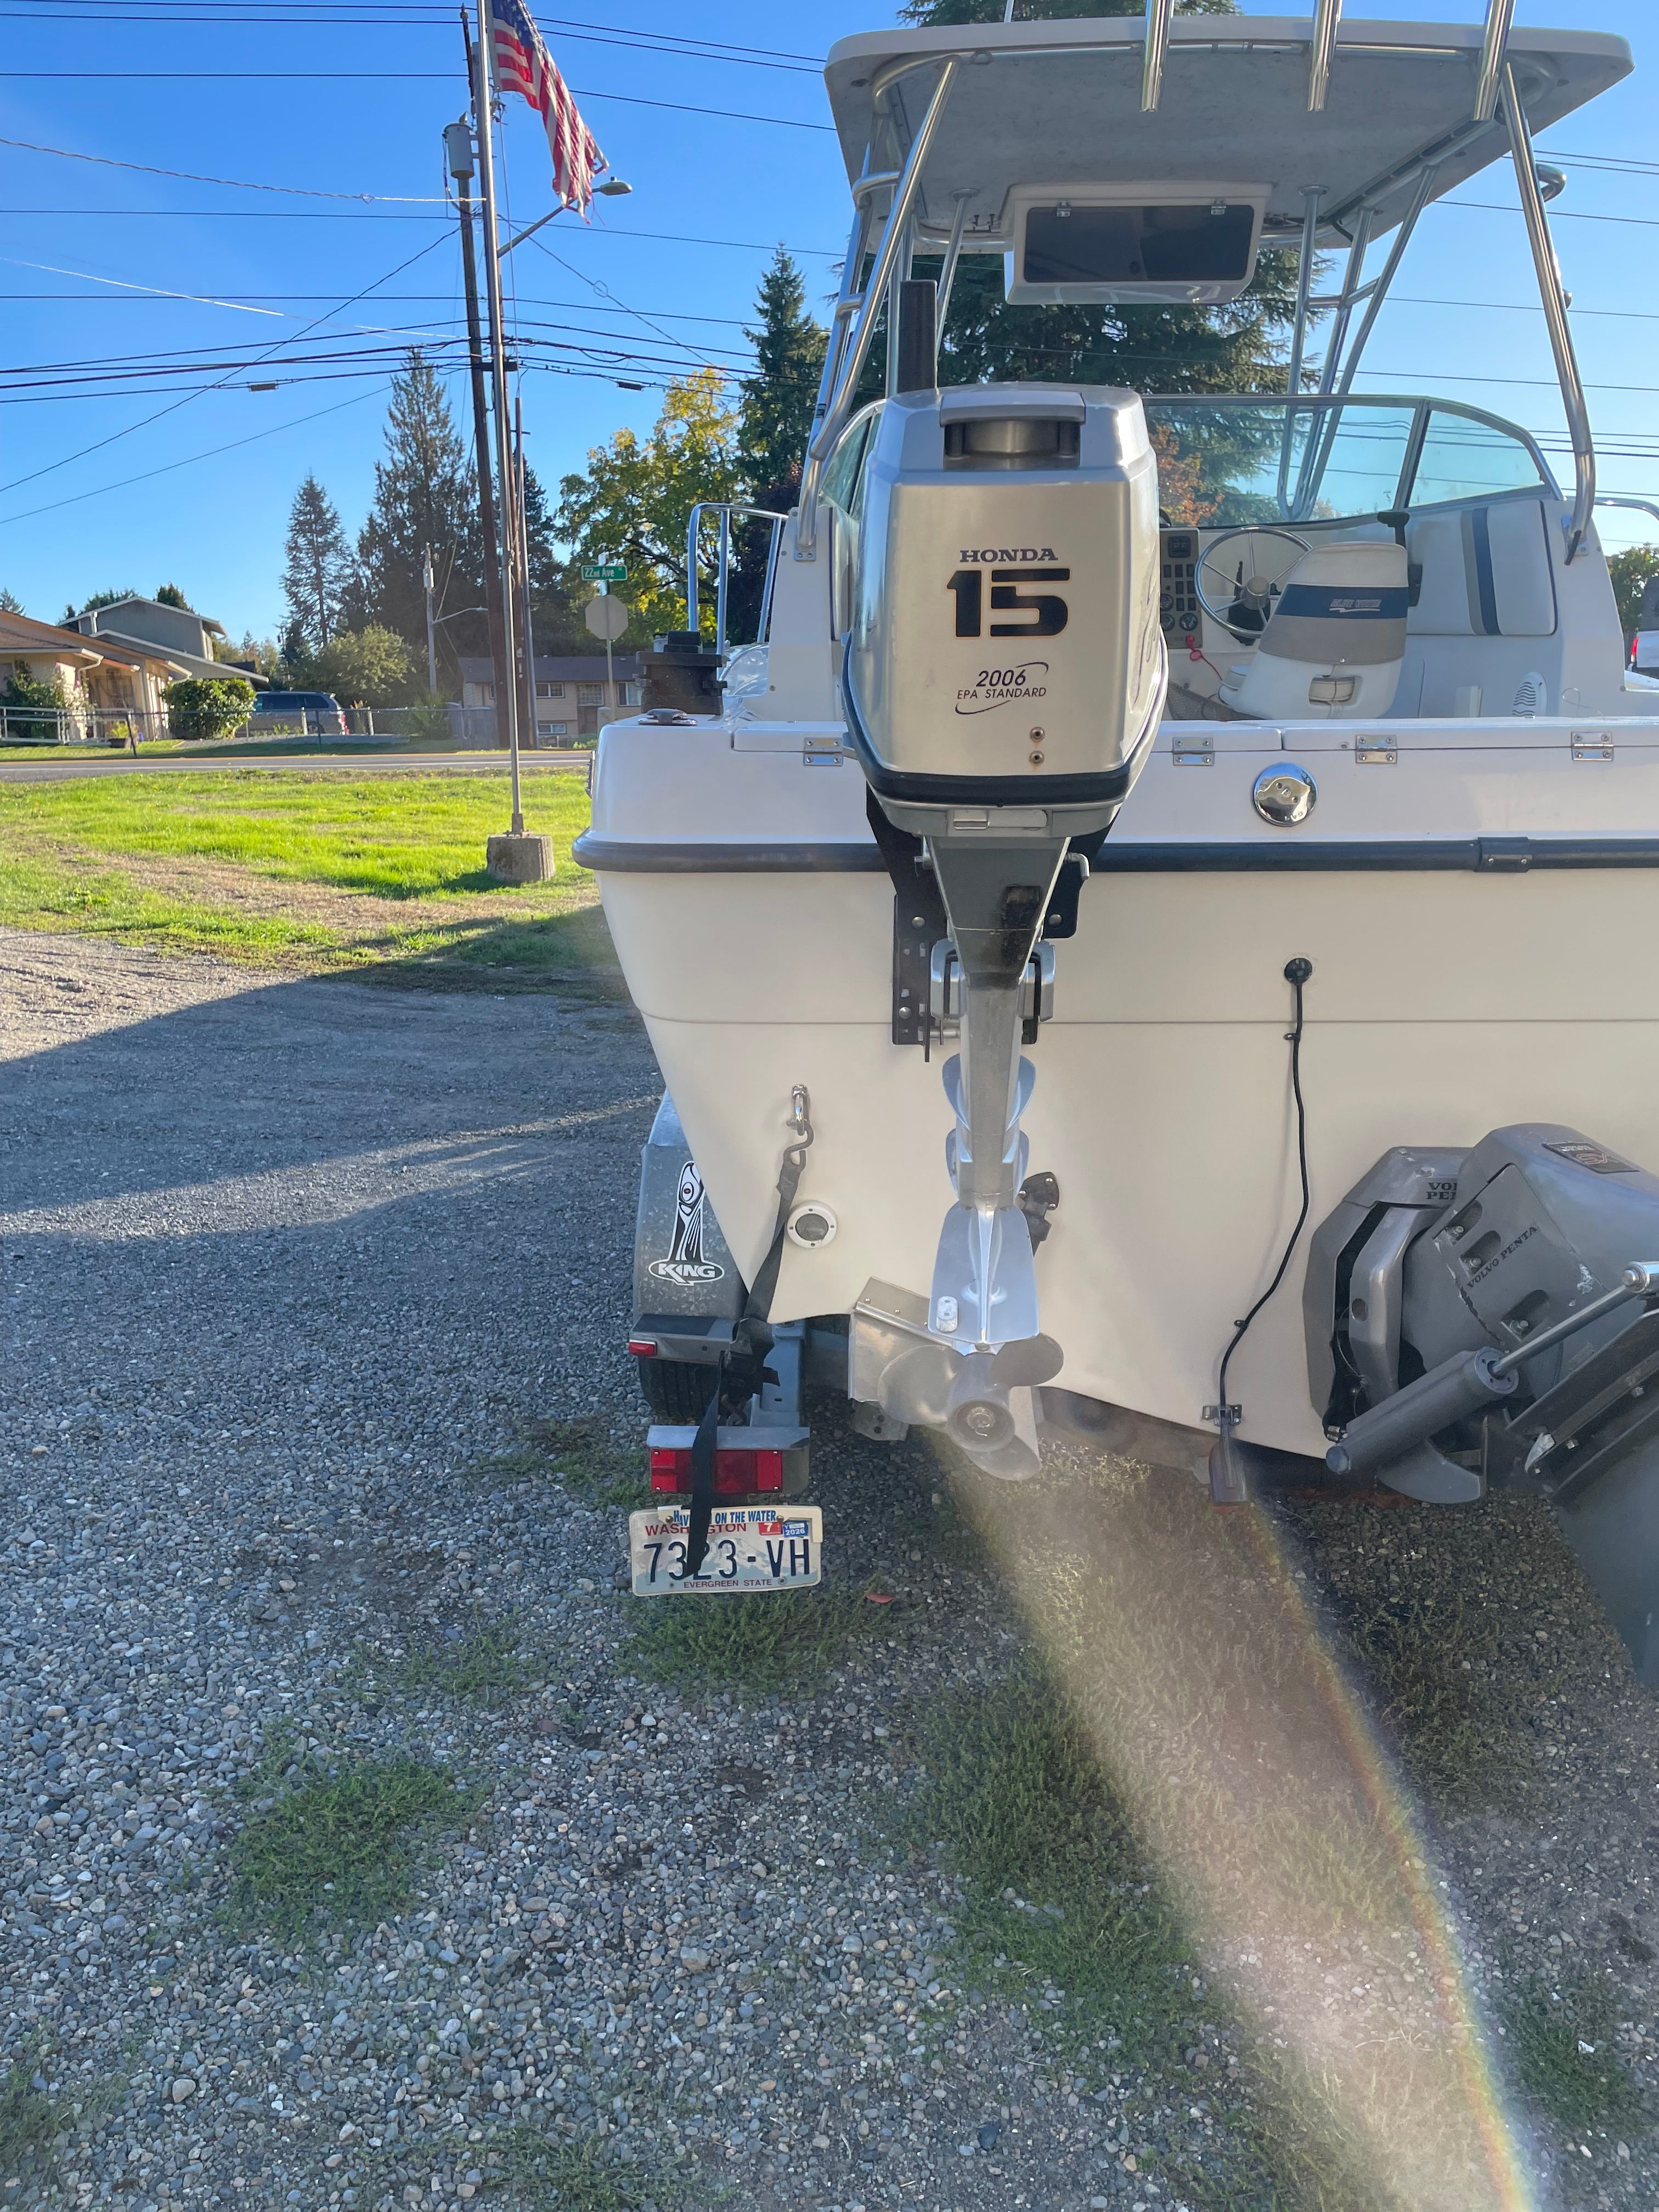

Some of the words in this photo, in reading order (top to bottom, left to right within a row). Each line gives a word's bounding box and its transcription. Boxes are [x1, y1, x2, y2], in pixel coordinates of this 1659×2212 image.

[960, 548, 1058, 562] HONDA
[601, 567, 614, 577] Ave
[945, 567, 1071, 638] 15
[976, 669, 1026, 687] 2006
[957, 689, 978, 699] EPA
[985, 686, 1047, 699] STANDARD
[1466, 1258, 1499, 1288] VOLVO
[1499, 1226, 1537, 1260] PENTA
[658, 1263, 715, 1283] KING
[715, 1512, 727, 1524] ON
[730, 1511, 746, 1523] THE
[748, 1510, 776, 1522] WATER
[645, 1523, 747, 1536] WASHGTON
[764, 1522, 773, 1532] 7
[684, 1579, 739, 1588] EVERGREEN
